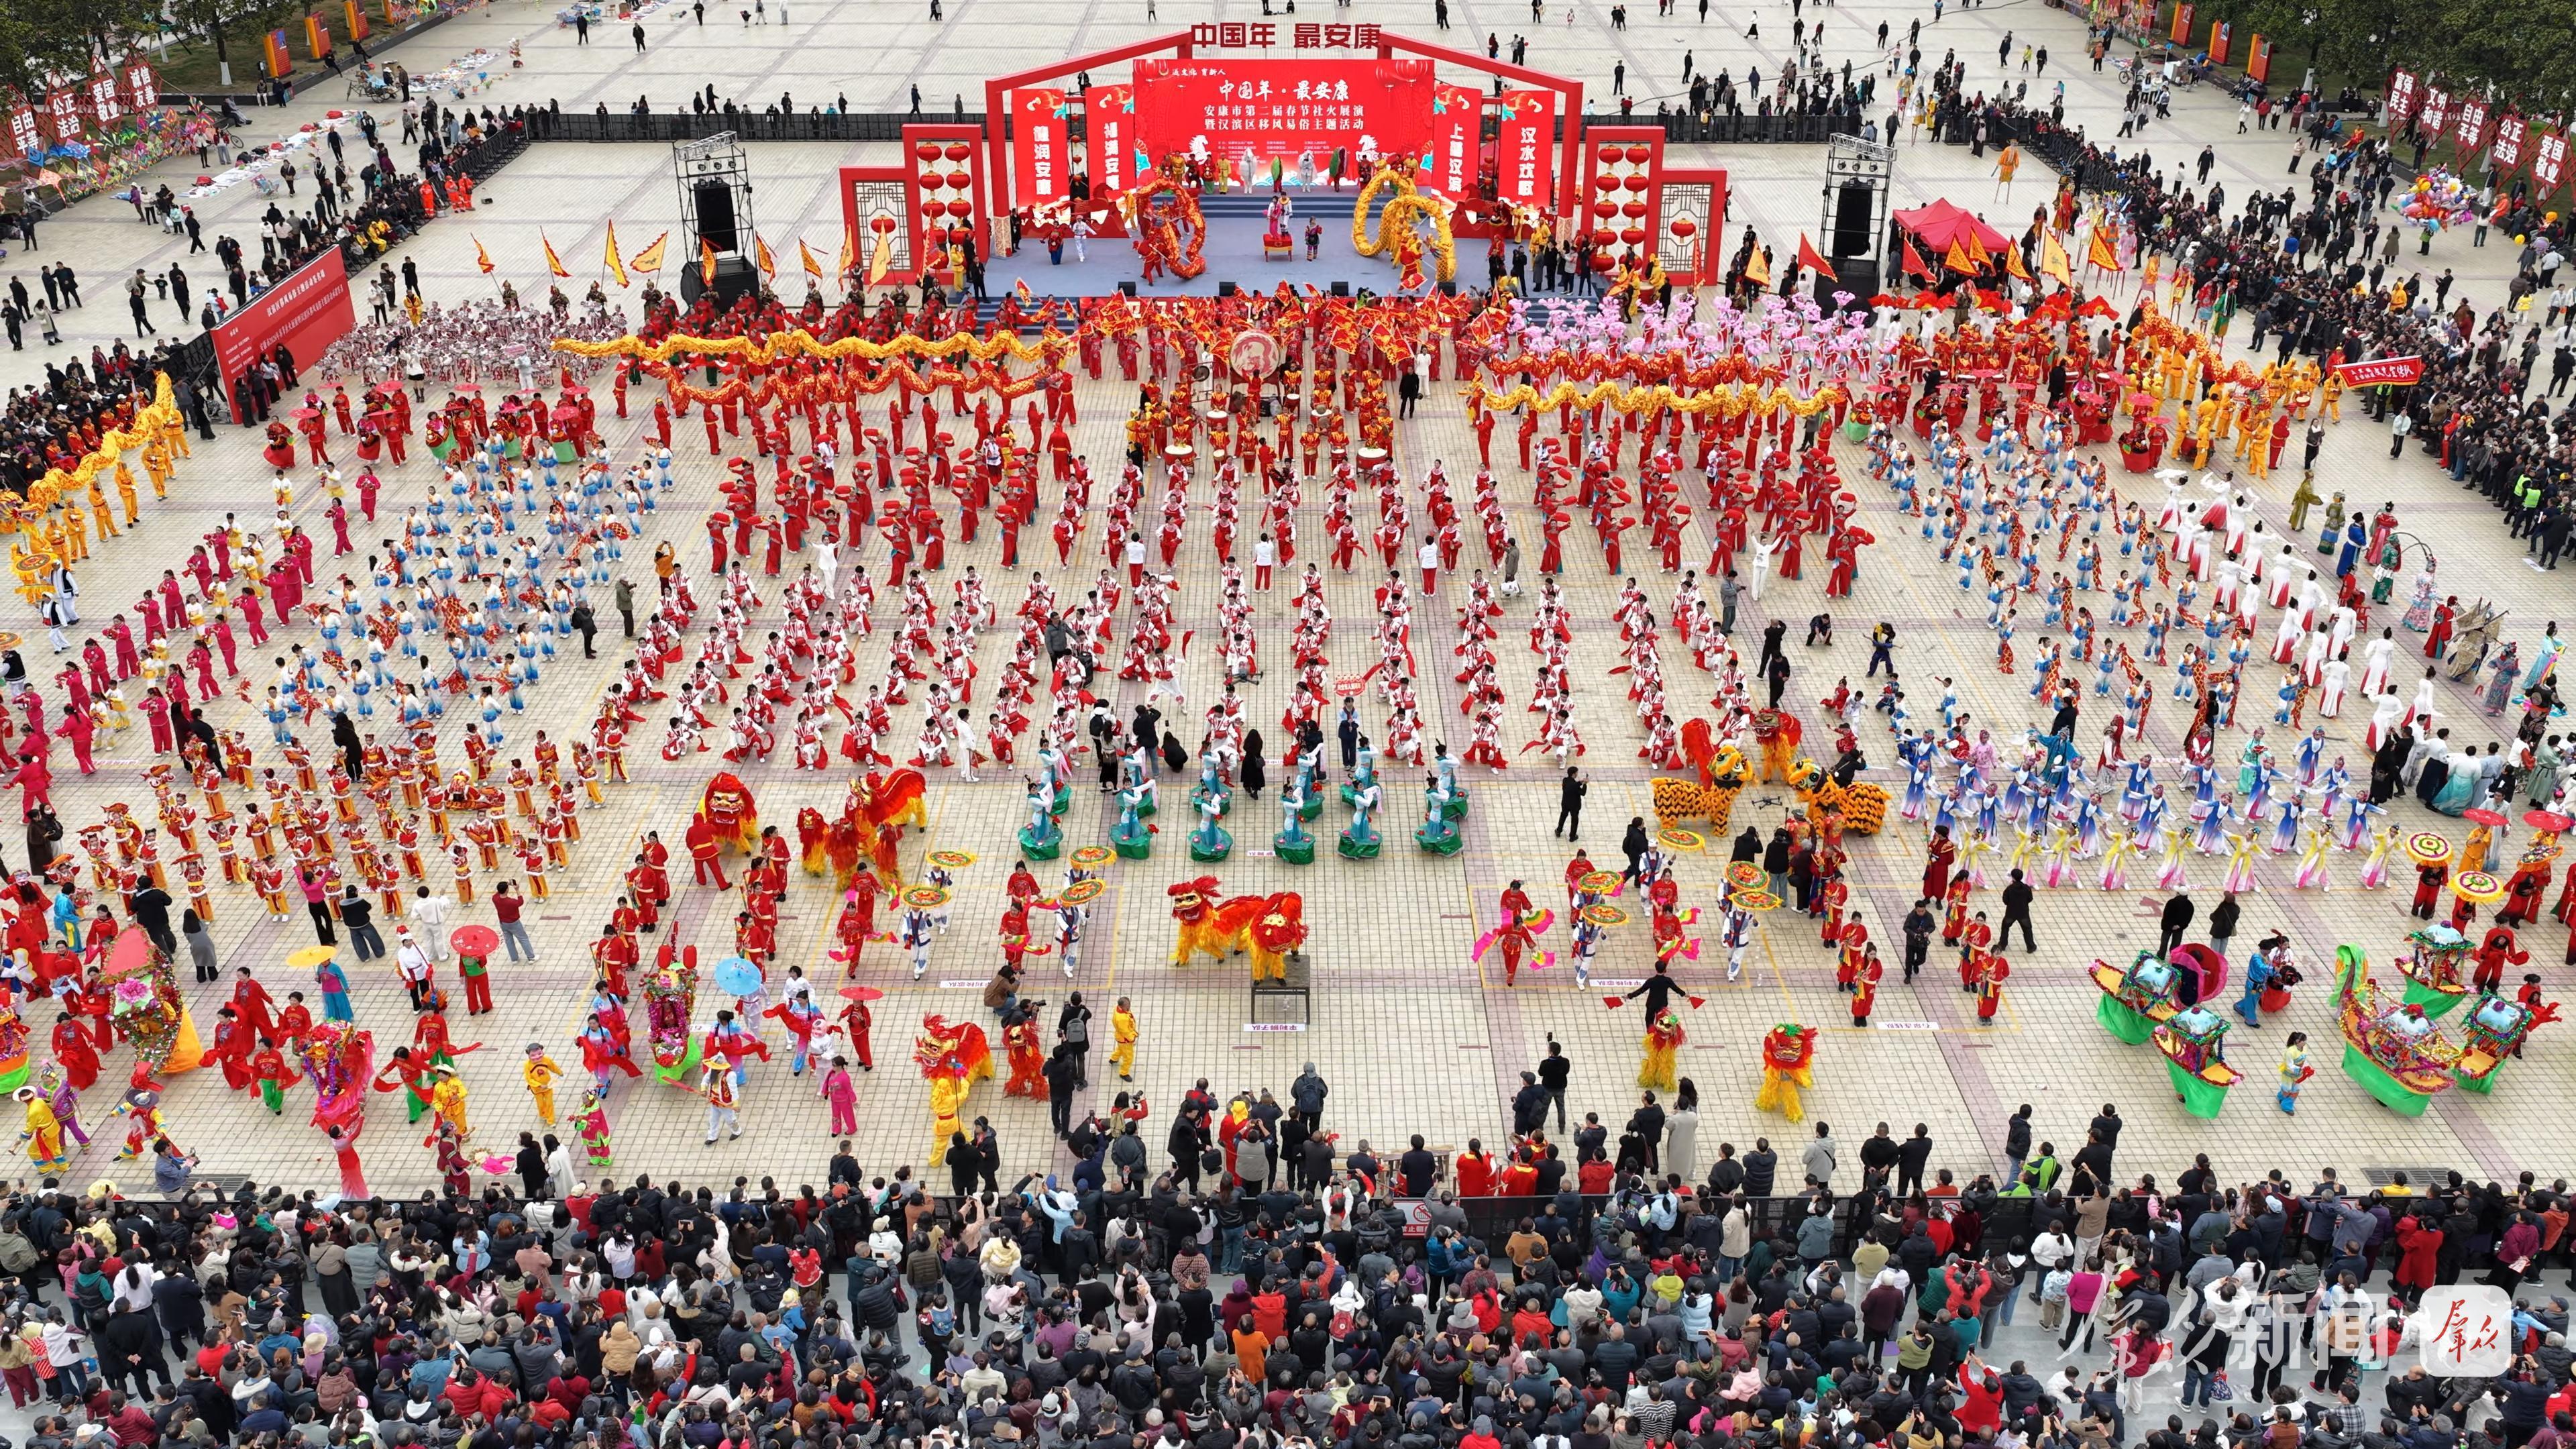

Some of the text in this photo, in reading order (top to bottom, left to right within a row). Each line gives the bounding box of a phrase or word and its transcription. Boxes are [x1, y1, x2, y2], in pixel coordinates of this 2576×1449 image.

[1191, 22, 1382, 49] 中国年 最安康
[129, 66, 151, 89] 诚信
[2394, 72, 2414, 95] 富强
[93, 78, 115, 103] 爱国
[135, 85, 156, 109] 友善
[1219, 79, 1349, 101] 中国年·最安康
[2426, 87, 2449, 110] 文明
[53, 93, 76, 116] 公正
[96, 100, 119, 122] 敬业
[1204, 105, 1364, 117] 安康市第二届春节社火展演
[2390, 91, 2408, 115] 民主
[2462, 103, 2483, 127] 自由
[11, 109, 34, 135] 自由
[56, 114, 80, 138] 法治
[1205, 118, 1364, 131] 暨汉滨区移风易俗主题活动
[2422, 106, 2443, 131] 和谐
[2500, 118, 2524, 143] 公正
[15, 130, 38, 155] 平等
[2457, 122, 2480, 147] 平等
[2493, 139, 2518, 165] 法治
[2539, 135, 2565, 162] 爱国
[1518, 127, 1537, 196] 汉水欢歌
[2536, 156, 2559, 184] 敬业
